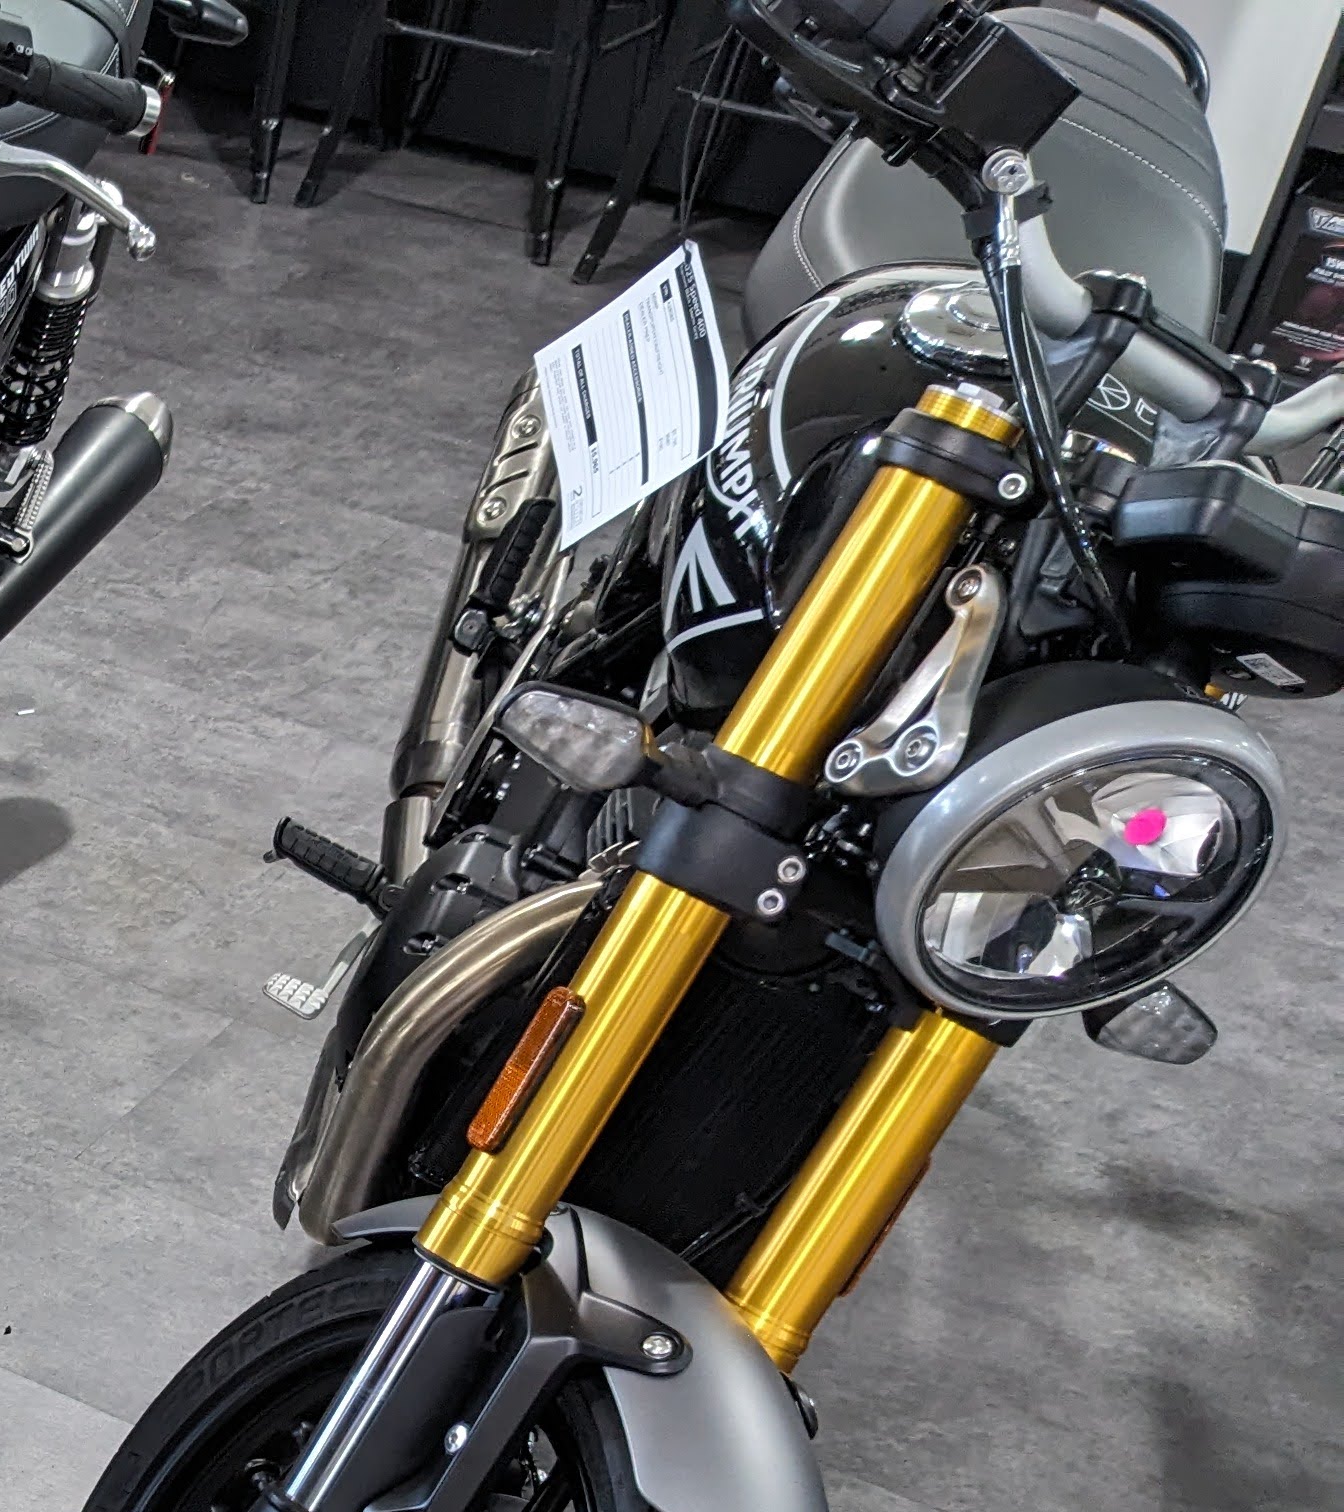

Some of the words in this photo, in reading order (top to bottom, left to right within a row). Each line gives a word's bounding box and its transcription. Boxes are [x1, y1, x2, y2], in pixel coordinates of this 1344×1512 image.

[686, 284, 701, 317] Speed
[696, 317, 706, 338] 400
[573, 348, 582, 369] TOTAL
[581, 388, 590, 420] CHARGES
[719, 346, 778, 541] TRIUMPH
